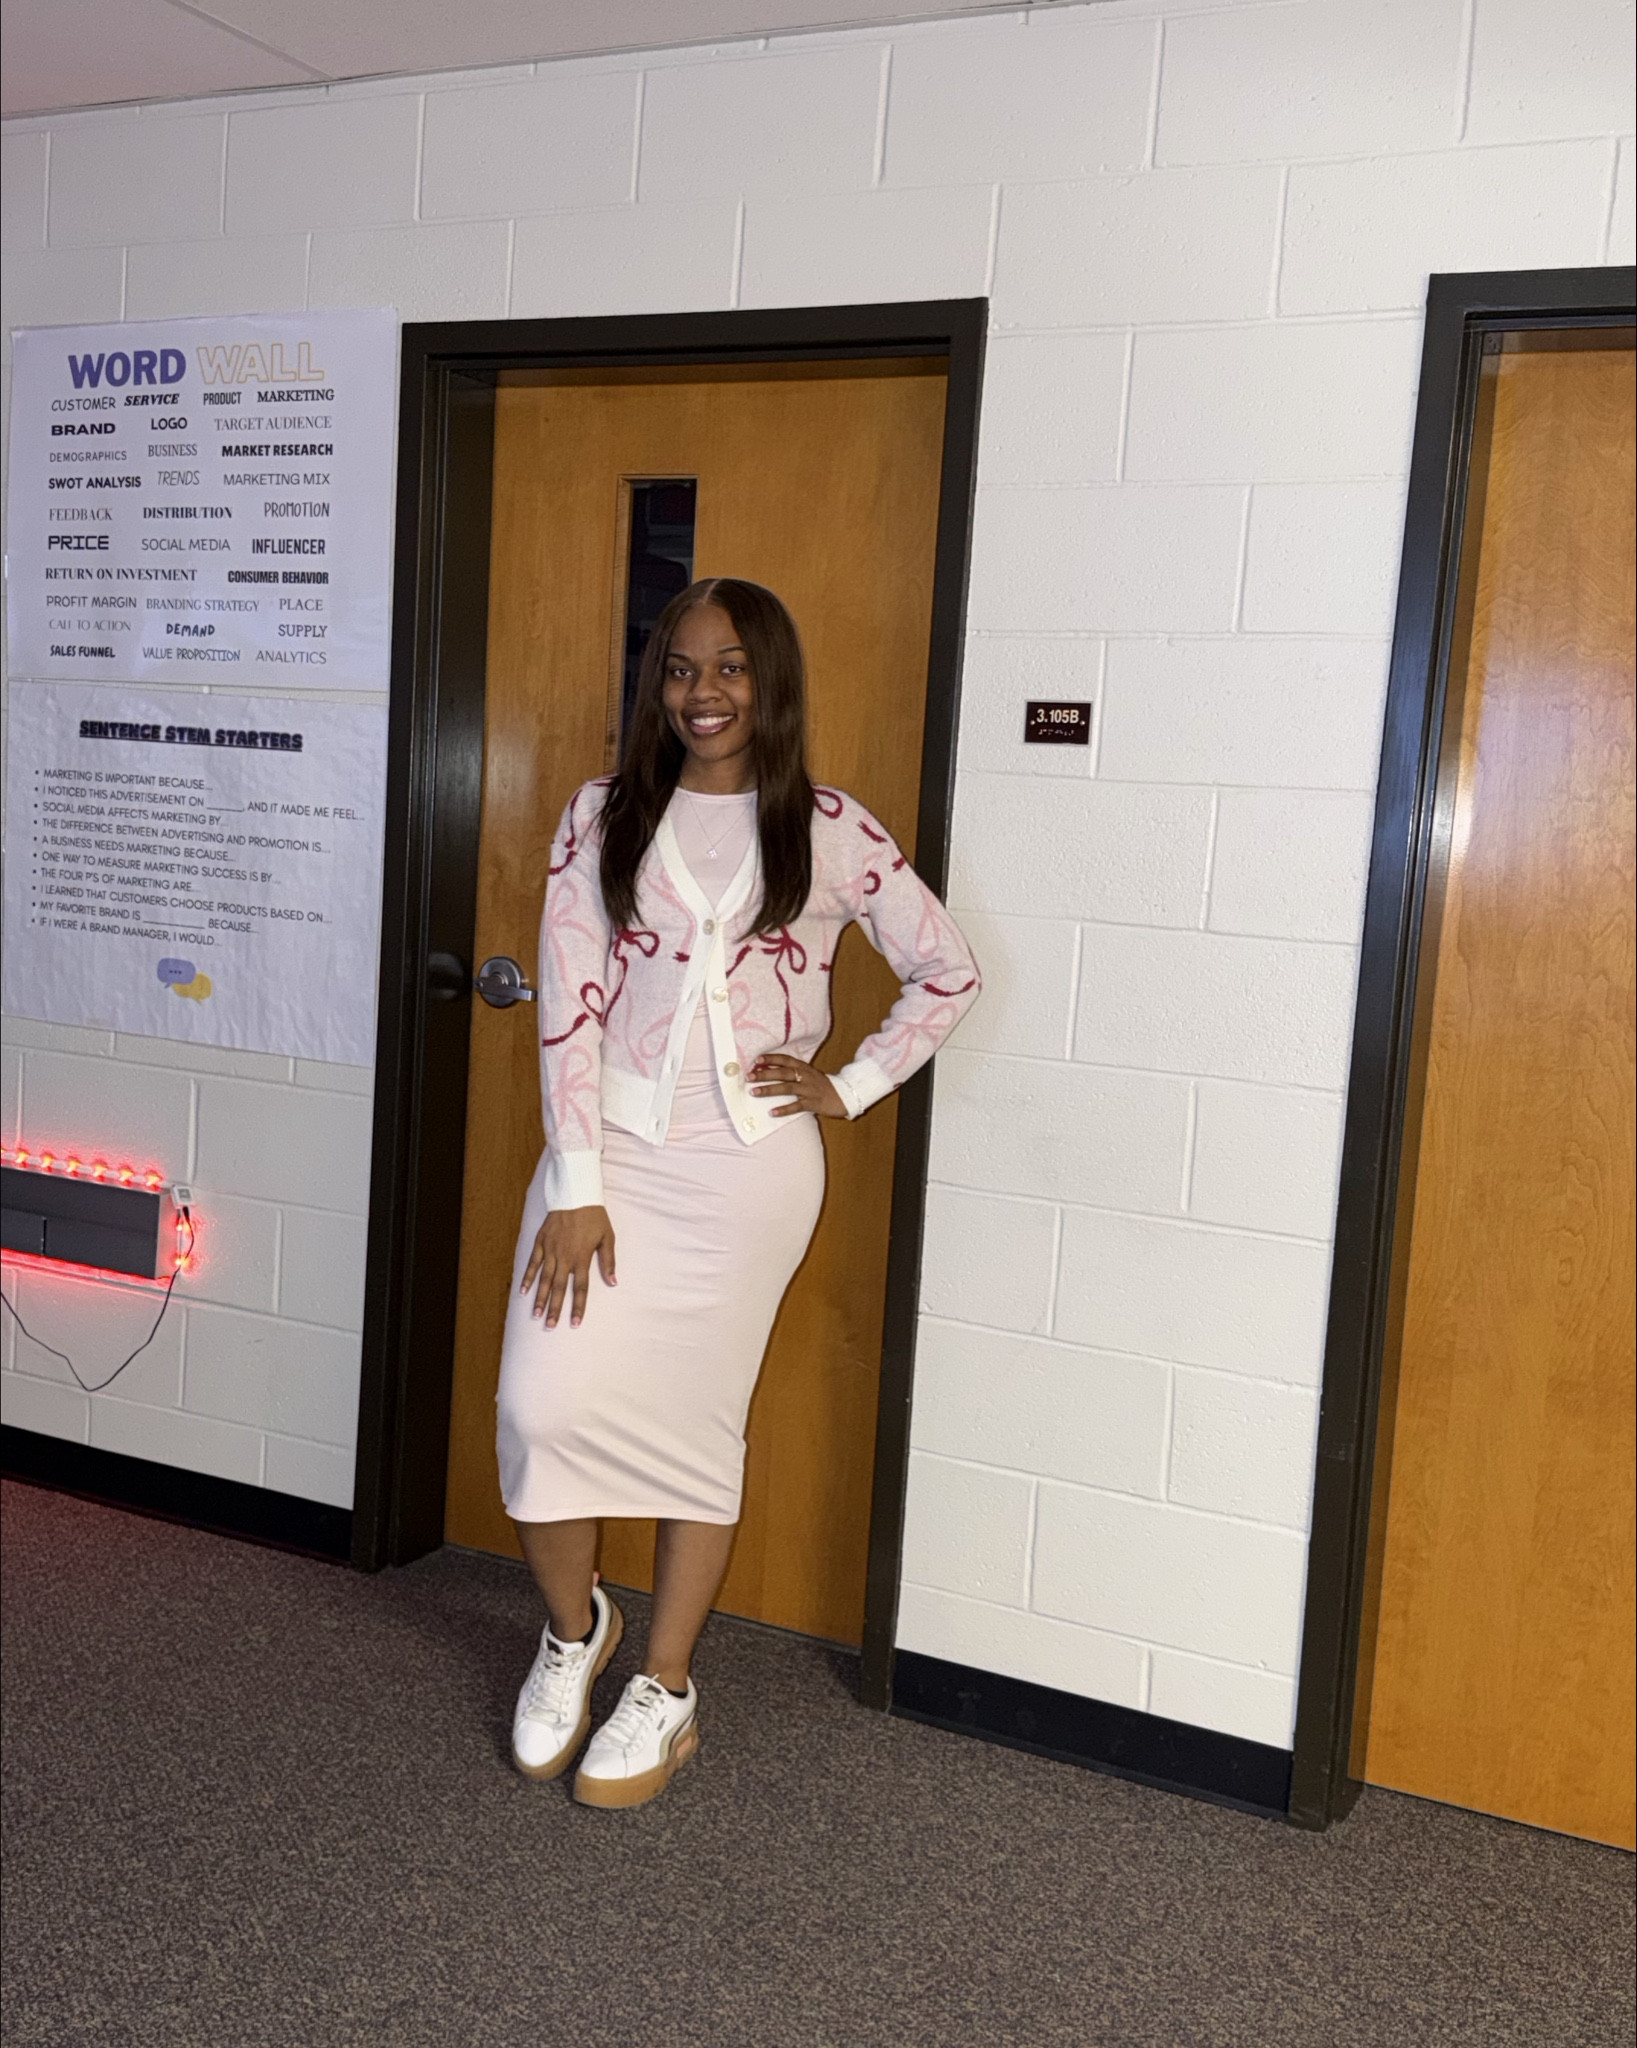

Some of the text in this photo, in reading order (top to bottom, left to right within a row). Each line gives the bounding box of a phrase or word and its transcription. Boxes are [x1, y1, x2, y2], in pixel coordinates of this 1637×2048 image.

[68, 342, 326, 389] WORD WALL
[51, 393, 180, 412] CUSTOMER SERVICE
[203, 391, 242, 406] PRODUCT
[257, 388, 335, 403] MARKETING
[51, 423, 116, 436] BRAND
[151, 417, 188, 431] LOGO
[214, 415, 332, 431] TARGET AUDIENCE
[49, 450, 127, 463] DEMOGRAPHICS
[148, 443, 198, 457] BUSINESS
[221, 443, 333, 457] MARKET RESEARCH
[48, 476, 142, 490] SWOT ANALYSIS
[157, 470, 200, 486] TRENDS
[223, 473, 330, 486] MARKETING MIX
[49, 507, 113, 521] FEEDBACK
[143, 506, 233, 519] DISTRIBUTION
[264, 501, 330, 518] PROMOTION
[48, 535, 109, 550] PRICE
[141, 538, 232, 551] SOCIAL MEDIA
[252, 538, 326, 555] INFLUENCER
[45, 567, 197, 581] RETURN ON INVESTMENT
[227, 570, 329, 584] CONSUMER BEHAVIOR
[46, 595, 137, 609] PROFIT MARGIN
[146, 598, 260, 612] BRANDING STRATEGY
[279, 598, 323, 611] PLACE
[77, 619, 91, 631] TO
[166, 623, 215, 637] DEMAND
[278, 624, 328, 638] SUPPLY
[50, 645, 116, 658] SALES FUNNEL
[142, 647, 241, 662] VALUE PROPOSITION
[255, 650, 327, 664] ANALYTICS
[1036, 708, 1080, 724] 3.105B
[79, 720, 303, 749] SENTENCE STEM STARTERS
[43, 769, 92, 782] MARKETING
[95, 772, 103, 782] IS
[105, 773, 156, 786] IMPORTANT
[43, 786, 46, 795] I
[48, 786, 87, 798] NOTICED
[89, 788, 108, 800] THIS
[110, 791, 186, 806] ADVERTISEMENT
[188, 796, 204, 807] ON
[247, 801, 268, 813] AND
[270, 803, 278, 813] IT
[281, 804, 311, 816] MADE
[313, 807, 329, 818] ME
[43, 802, 75, 814] SOCIAL
[77, 805, 106, 816] MEDIA
[108, 807, 149, 820] AFFECTS
[151, 811, 206, 825] MARKETING
[43, 818, 58, 829] THE
[60, 819, 113, 834] DIFFERENCE
[116, 825, 159, 838] BETWEEN
[161, 828, 224, 844] ADVERTISING
[226, 835, 246, 846] AND
[248, 836, 309, 851] PROMOTION
[42, 835, 49, 844] A
[51, 835, 92, 849] BUSINESS
[95, 840, 125, 852] NEEDS
[126, 843, 181, 857] MARKETING
[42, 851, 60, 862] ONE
[63, 853, 81, 864] WAY
[83, 855, 95, 866] TO
[97, 857, 141, 871] MEASURE
[143, 861, 199, 876] MARKETING
[201, 866, 247, 881] SUCCESS
[249, 871, 259, 882] IS
[41, 867, 56, 879] THE
[59, 869, 83, 881] FOUR
[86, 872, 99, 883] P'S
[102, 874, 115, 885] OF
[117, 876, 170, 890] MARKETING
[41, 885, 44, 894] I
[45, 885, 84, 898] LEARNED
[86, 888, 107, 900] THAT
[109, 891, 168, 907] CUSTOMERS
[170, 897, 215, 912] CHOOSE
[217, 902, 268, 917] PRODUCTS
[270, 907, 304, 921] BASED
[40, 901, 54, 911] MY
[56, 902, 97, 916] FAVORITE
[99, 906, 130, 919] BRAND
[132, 910, 141, 921] IS
[40, 917, 47, 927] IF
[53, 919, 78, 931] WERE
[80, 921, 87, 932] A
[89, 922, 120, 935] BRAND
[122, 926, 172, 942] MANAGER,
[173, 932, 177, 942] I
